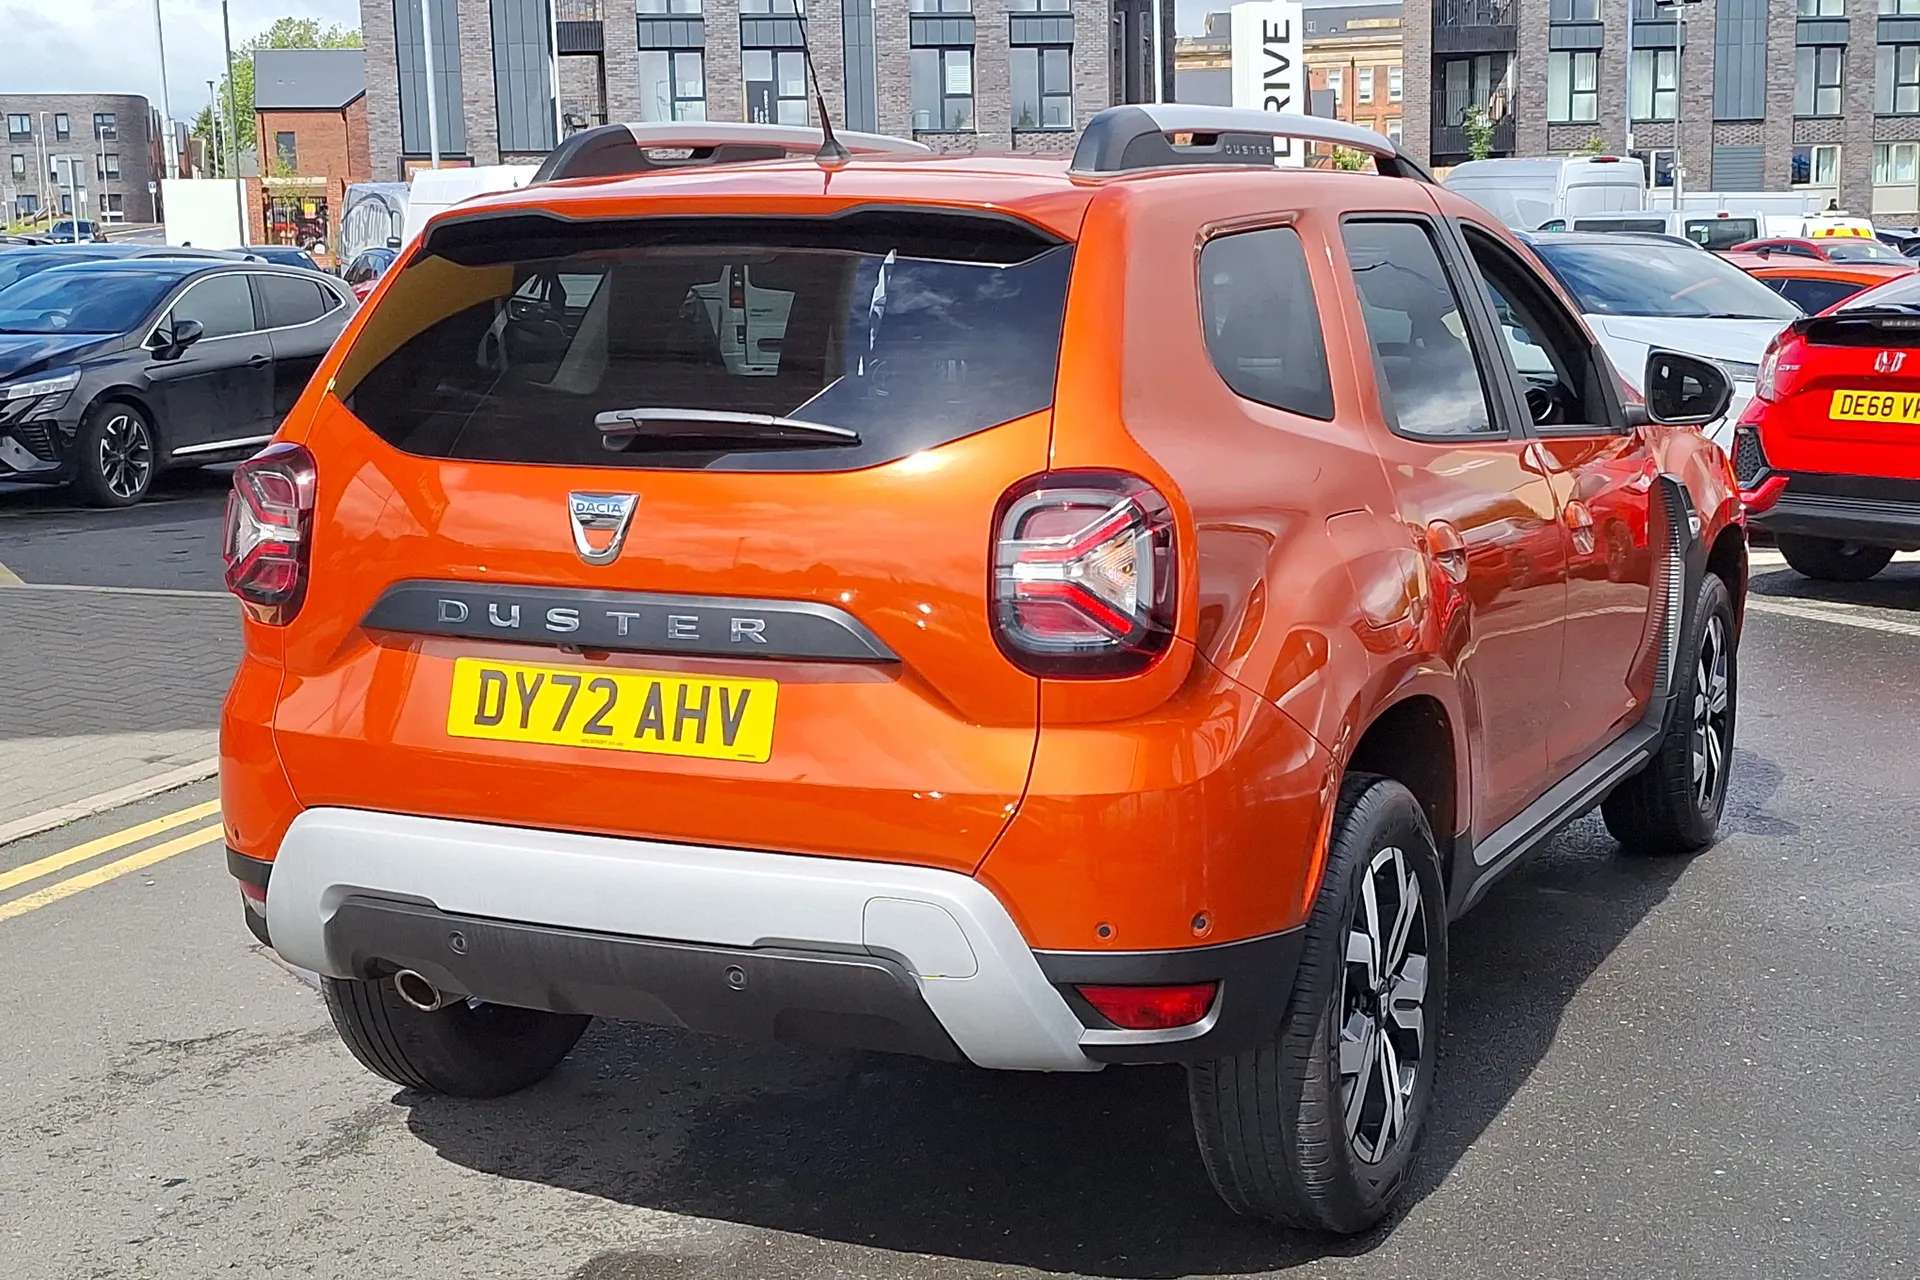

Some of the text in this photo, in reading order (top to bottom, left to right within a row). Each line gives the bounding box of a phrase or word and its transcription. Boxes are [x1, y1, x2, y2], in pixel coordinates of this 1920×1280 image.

[1225, 144, 1273, 155] DUSTER
[1839, 394, 1895, 417] DE68
[576, 502, 622, 513] DACIA
[437, 599, 768, 644] DUSTER
[473, 668, 752, 747] DY72 AHV
